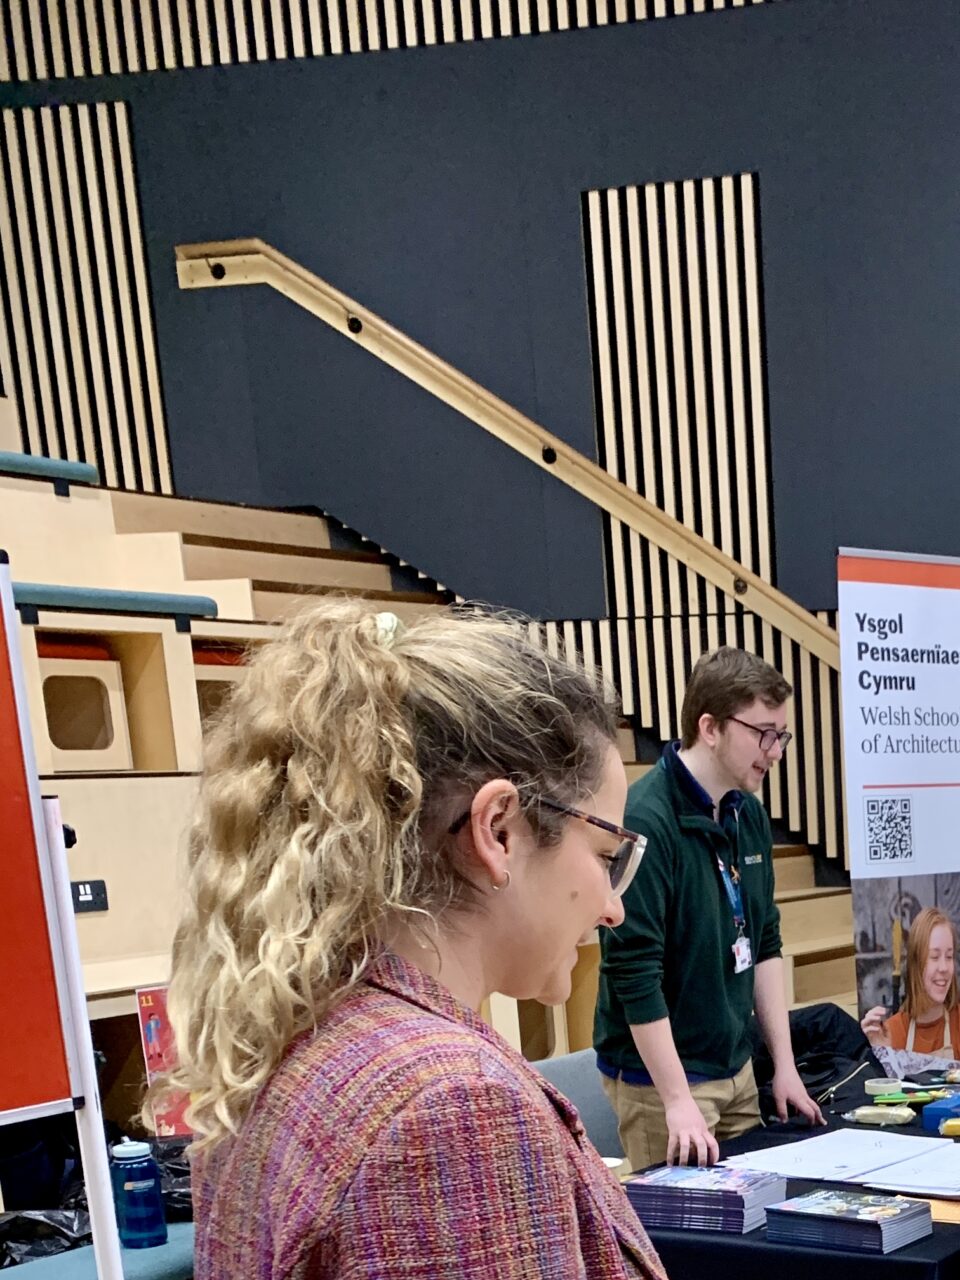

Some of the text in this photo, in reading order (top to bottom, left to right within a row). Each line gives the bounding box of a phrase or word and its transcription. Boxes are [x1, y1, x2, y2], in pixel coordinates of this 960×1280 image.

[855, 612, 904, 640] Ysgol
[858, 670, 915, 695] Cymru
[859, 705, 911, 726] Welsh
[861, 733, 881, 754] of
[140, 995, 154, 1007] 11
